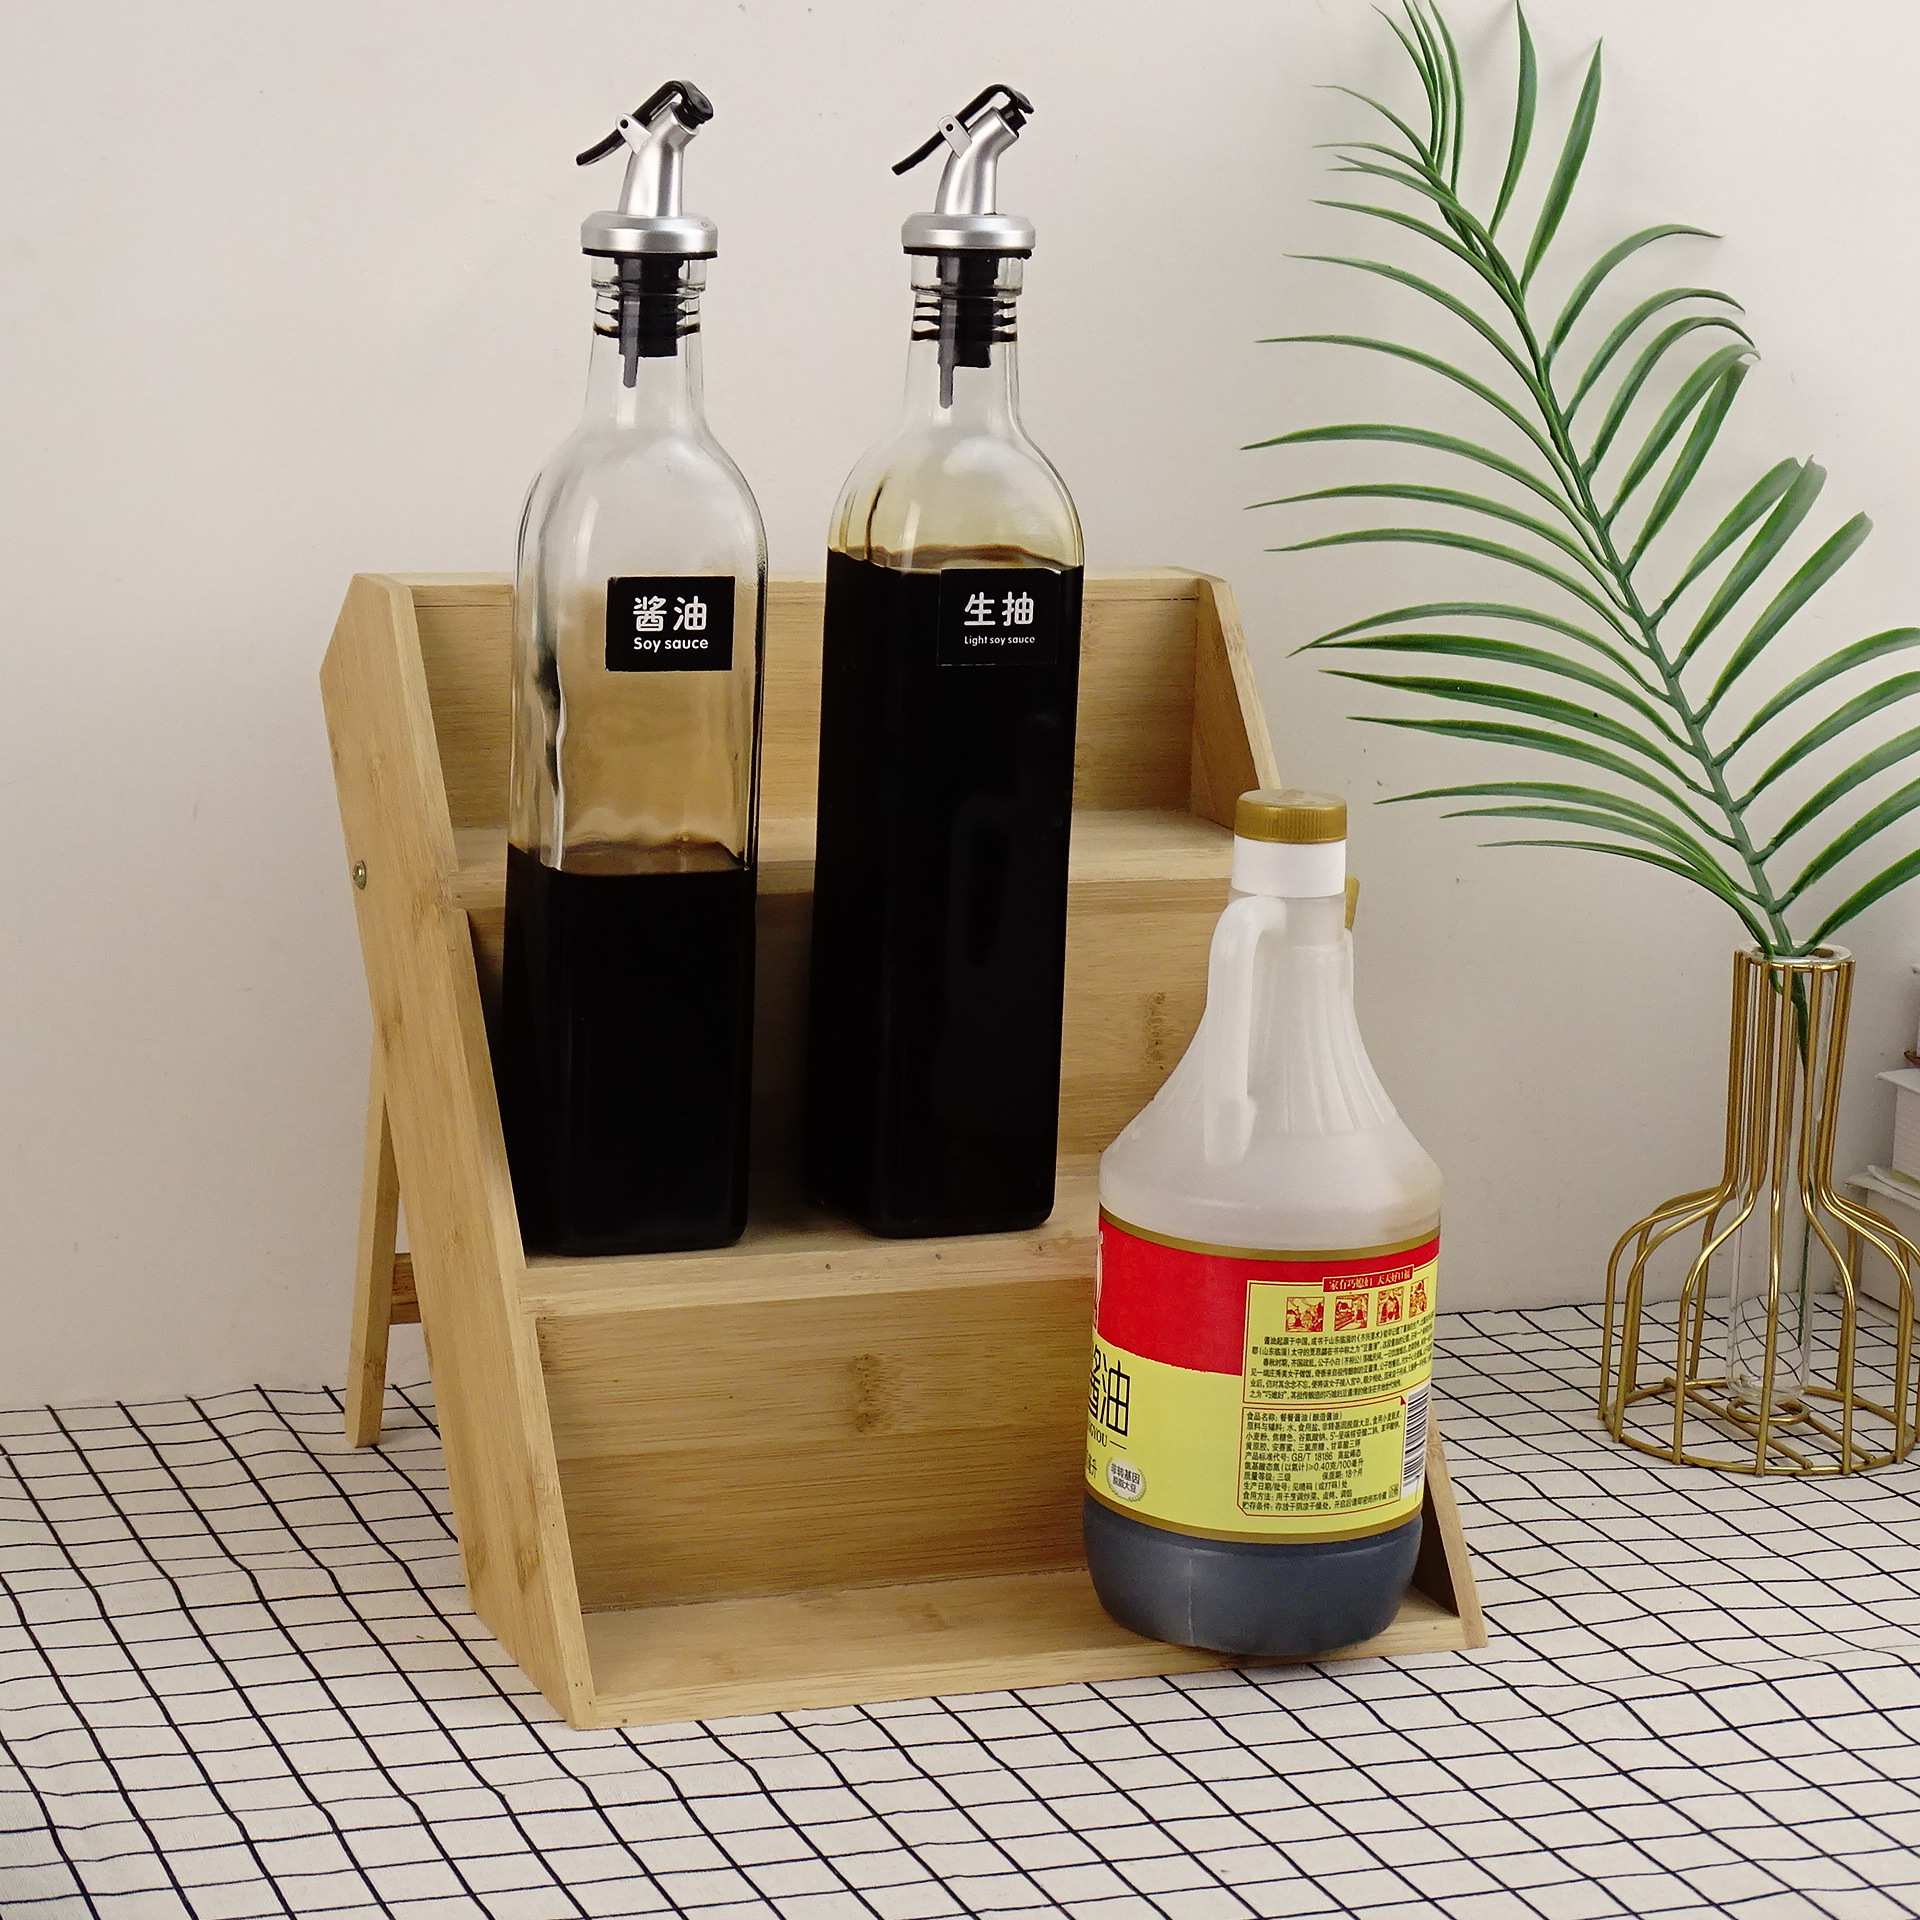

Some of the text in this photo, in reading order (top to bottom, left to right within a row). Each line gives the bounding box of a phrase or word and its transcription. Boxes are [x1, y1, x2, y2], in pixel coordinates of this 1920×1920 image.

[633, 595, 707, 632] 酱油
[964, 591, 1034, 626] 生抽
[633, 636, 709, 653] Soy sauce
[964, 635, 1036, 647] Light soy sauce
[1110, 1462, 1141, 1486] 非转基因
